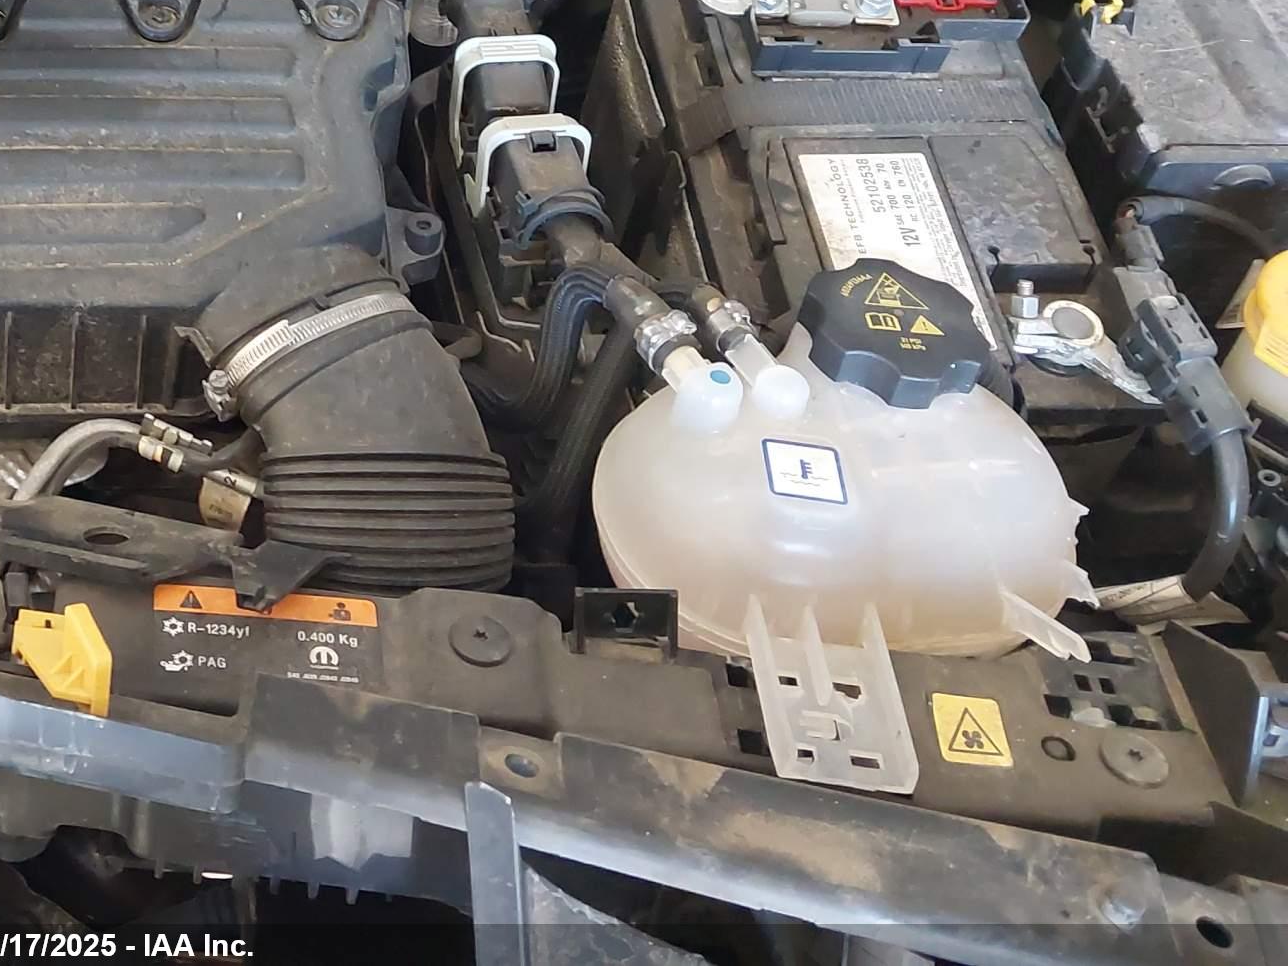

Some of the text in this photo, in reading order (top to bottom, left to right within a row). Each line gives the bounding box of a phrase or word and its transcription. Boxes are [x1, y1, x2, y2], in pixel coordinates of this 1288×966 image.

[876, 163, 886, 173] 70
[890, 160, 903, 176] 760
[855, 158, 886, 213] 52102538
[827, 158, 858, 230] TECHNOLOGY
[887, 194, 899, 210] 700
[902, 194, 915, 209] 120
[853, 234, 867, 255] EFB
[898, 227, 921, 246] 12V
[187, 623, 250, 639] R-1234yf
[297, 630, 359, 648] 0.400 Kg
[197, 656, 227, 668] PAG
